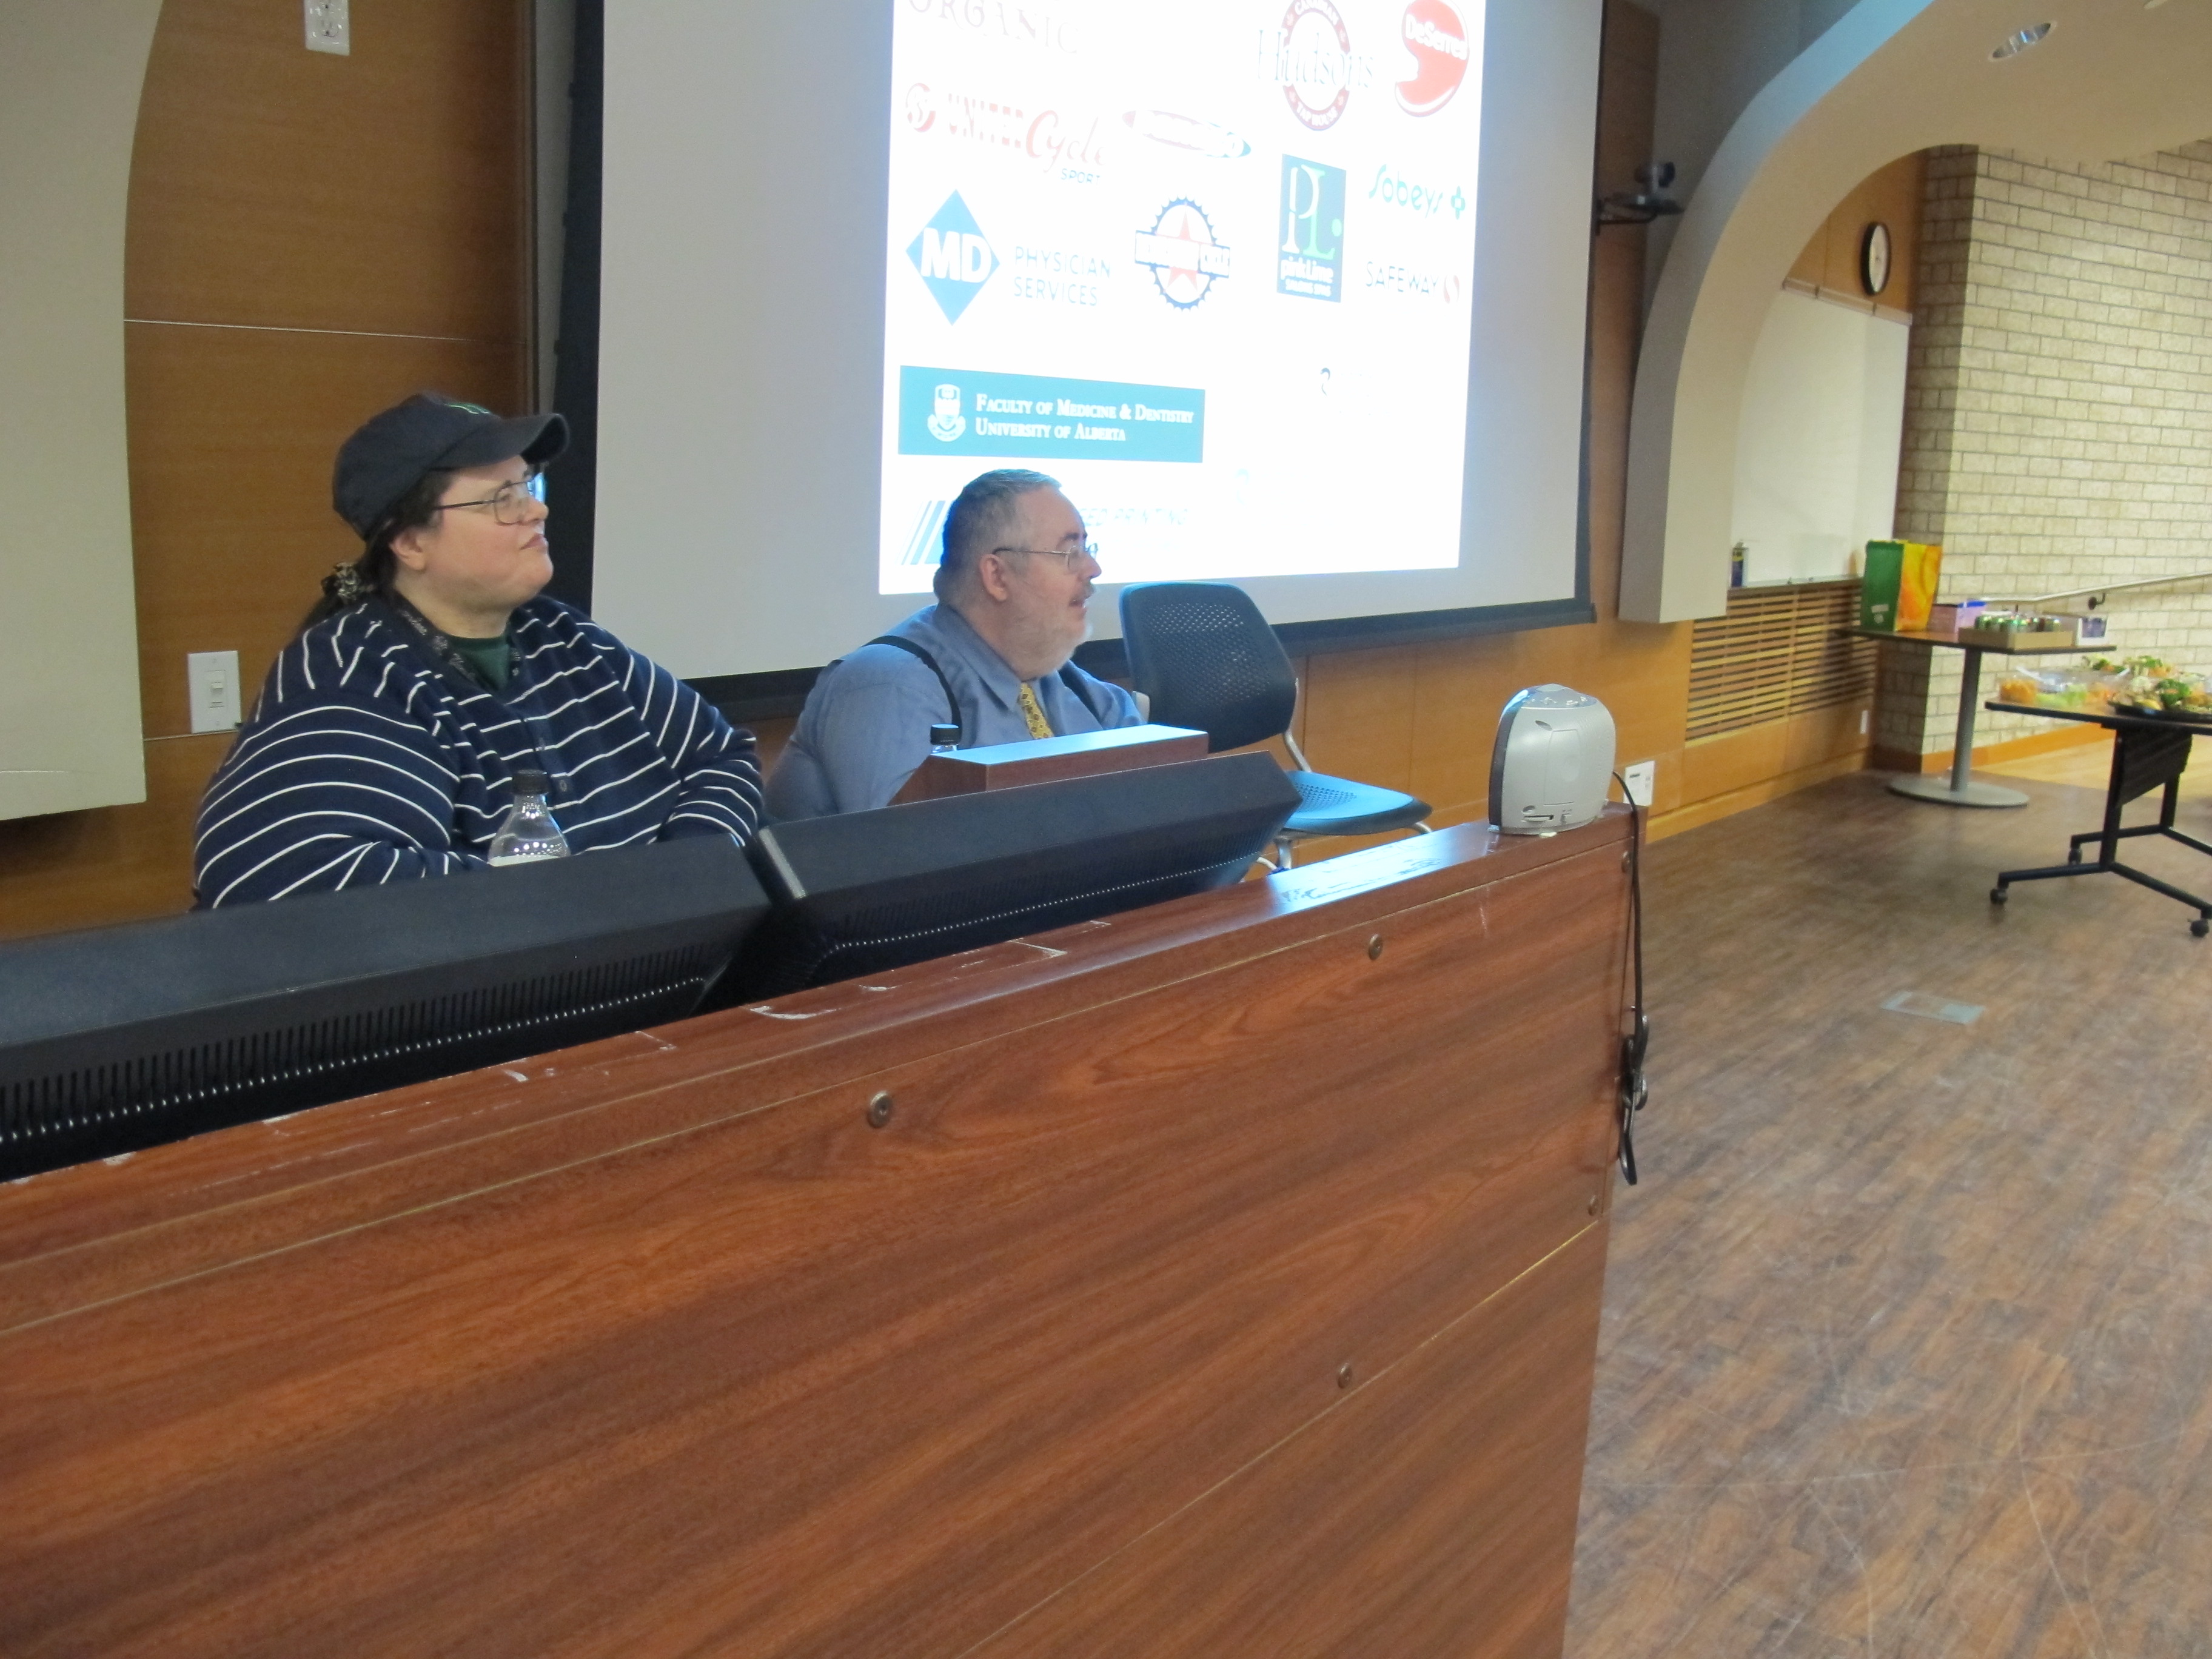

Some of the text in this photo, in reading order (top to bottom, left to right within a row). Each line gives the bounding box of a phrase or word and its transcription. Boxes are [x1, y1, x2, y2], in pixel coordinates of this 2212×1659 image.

[1368, 164, 1444, 219] Sobeys
[920, 227, 992, 283] MD
[1014, 246, 1111, 278] PHYSICIAN
[1014, 276, 1098, 307] SERVICES
[1366, 261, 1439, 297] SAFEWAY
